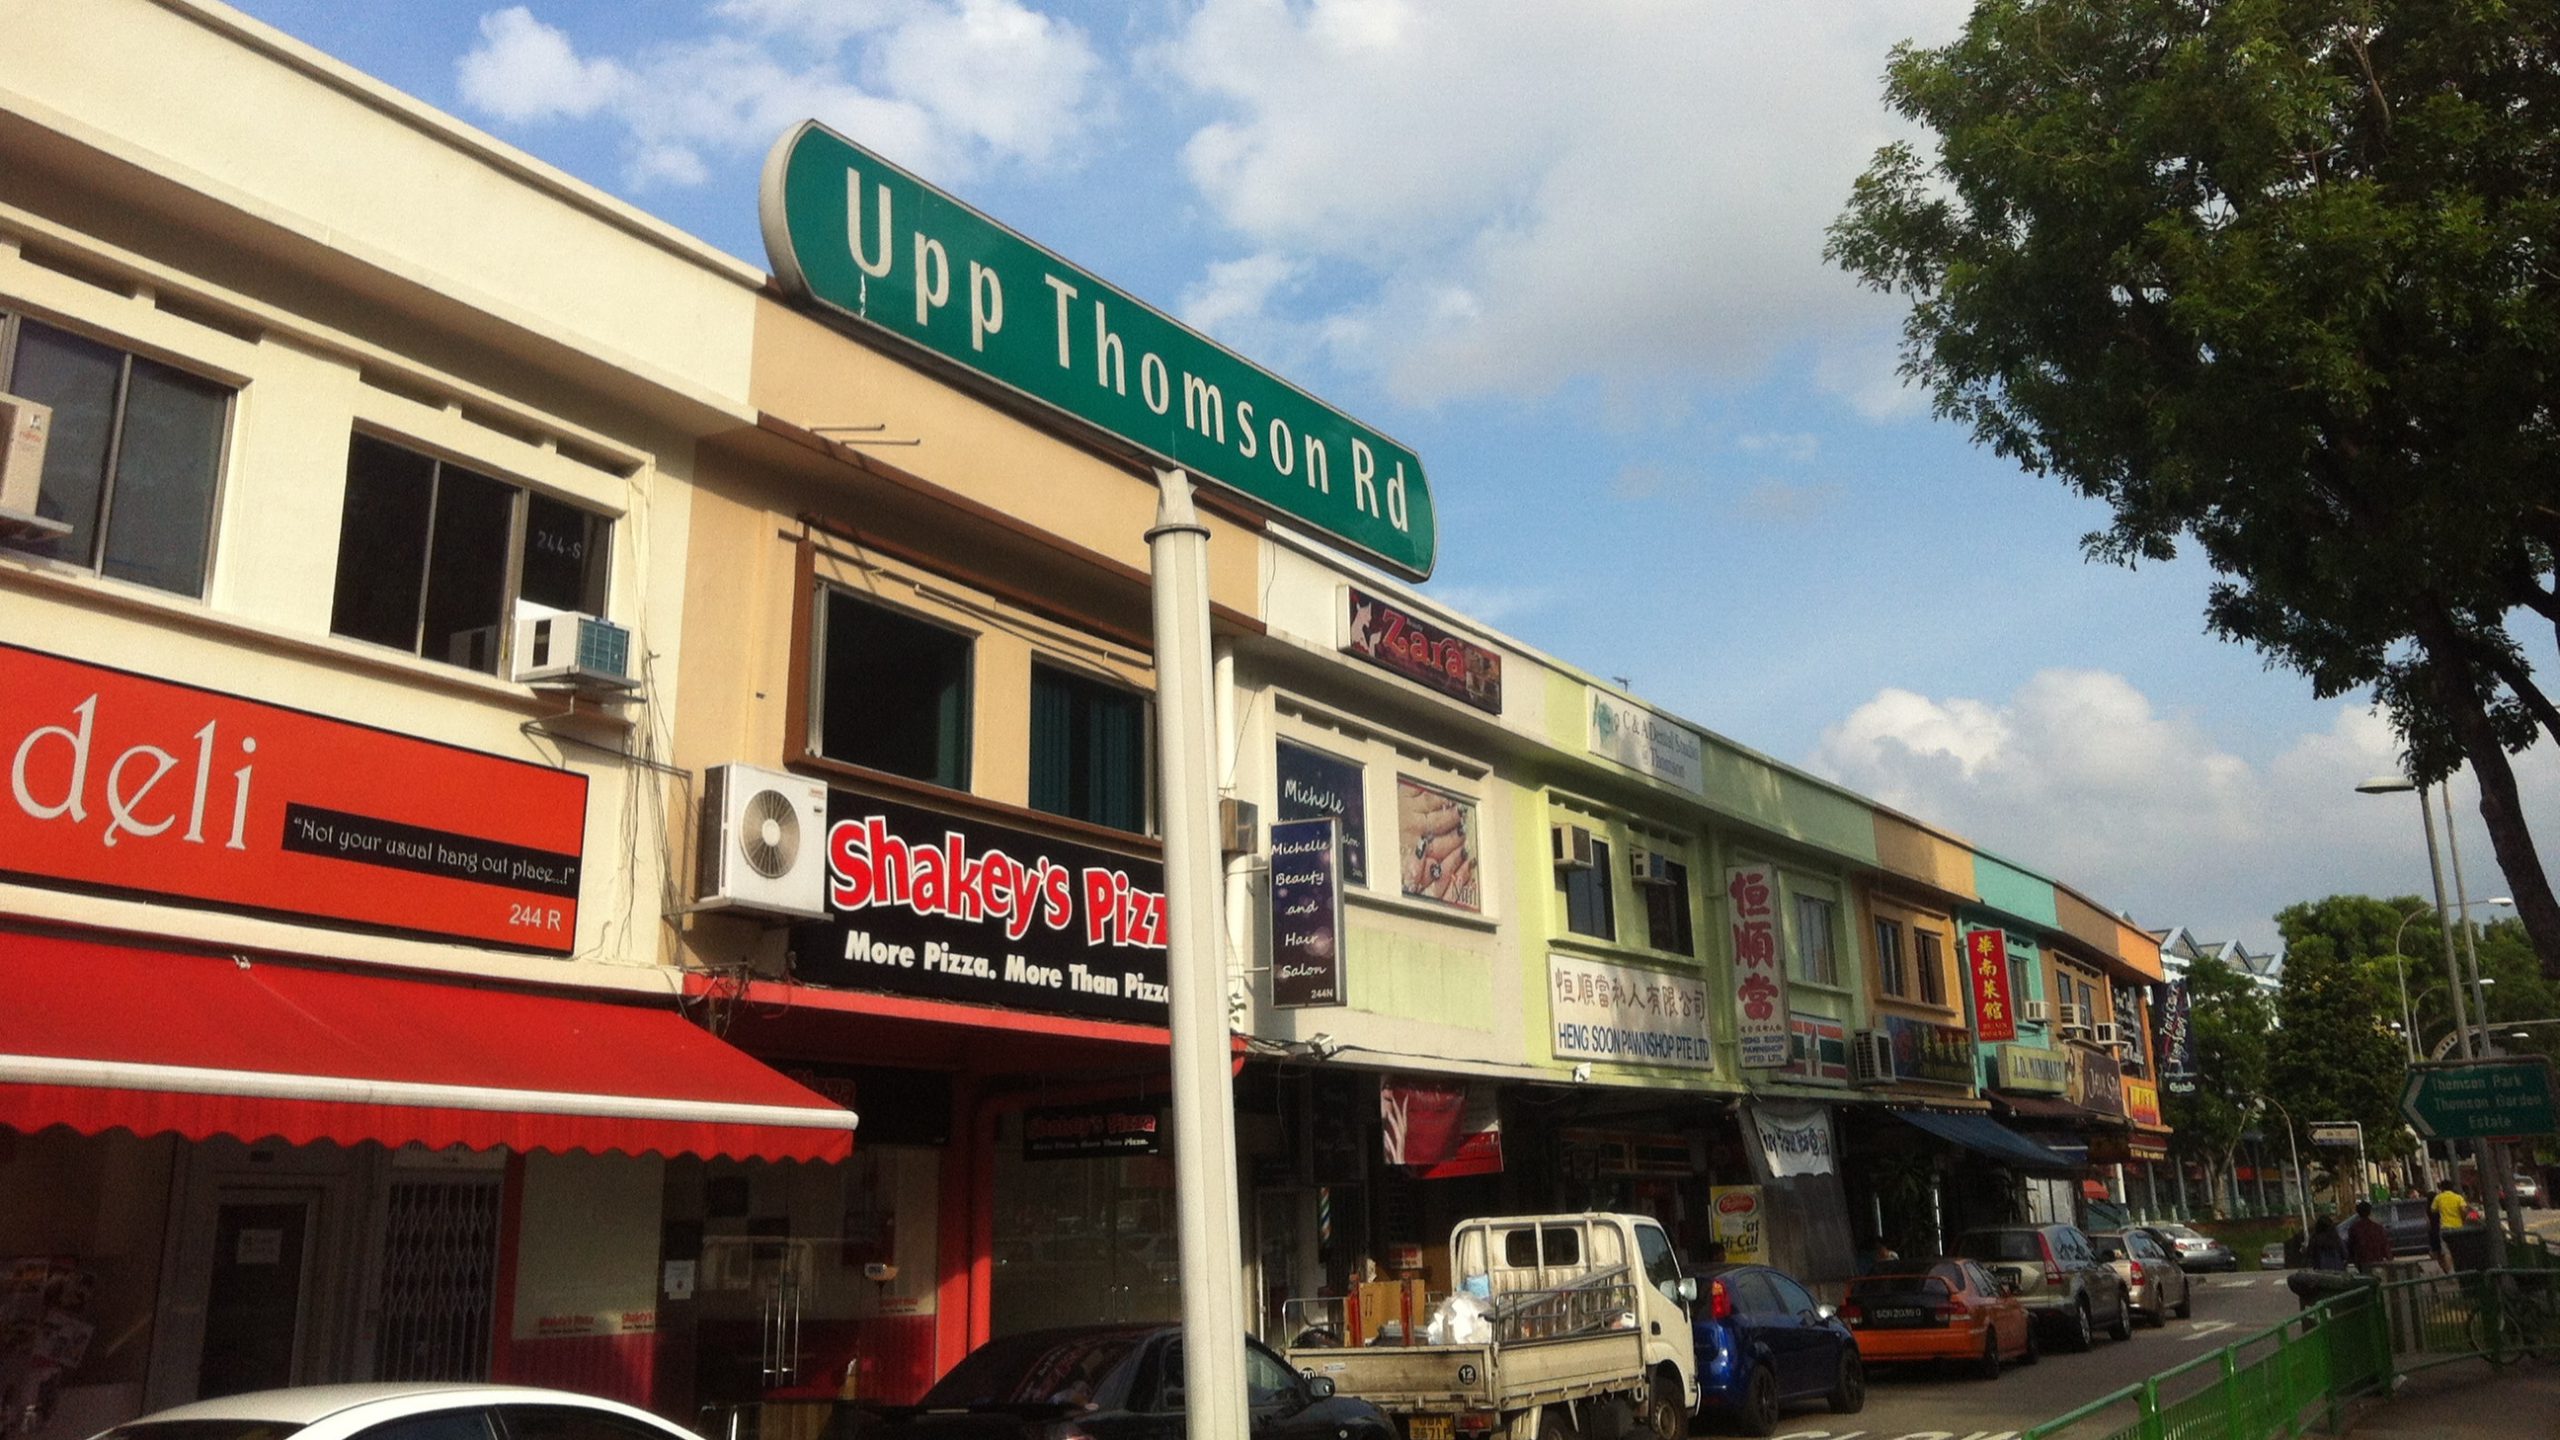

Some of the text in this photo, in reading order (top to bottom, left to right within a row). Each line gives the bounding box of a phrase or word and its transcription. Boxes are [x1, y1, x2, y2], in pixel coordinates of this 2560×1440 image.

[847, 166, 1408, 533] Upp Thomson Rd
[1382, 609, 1467, 680] Zara
[12, 693, 256, 850] deli
[1285, 778, 1344, 814] Michelle
[339, 828, 382, 854] your
[386, 839, 433, 863] usual
[437, 846, 477, 873] hang
[482, 857, 508, 876] out
[1271, 841, 1330, 856] Michelle
[827, 815, 1168, 949] Shakey's Pizz
[1276, 871, 1324, 886] Beauty
[509, 904, 561, 932] 244 R
[1285, 902, 1319, 916] and
[1285, 932, 1317, 946] Hair
[845, 930, 915, 969] More
[924, 941, 997, 980] Pizza.
[1005, 954, 1063, 989] More
[1069, 963, 1119, 997] Than
[1282, 964, 1327, 979] Salon
[1558, 1022, 1709, 1062] HENG SOON PAWNSHOP PTE LTD
[2431, 1074, 2522, 1092] Thomson Park
[2434, 1097, 2489, 1112] Thomson
[2468, 1115, 2512, 1130] Estate
[1460, 1367, 1474, 1379] 12
